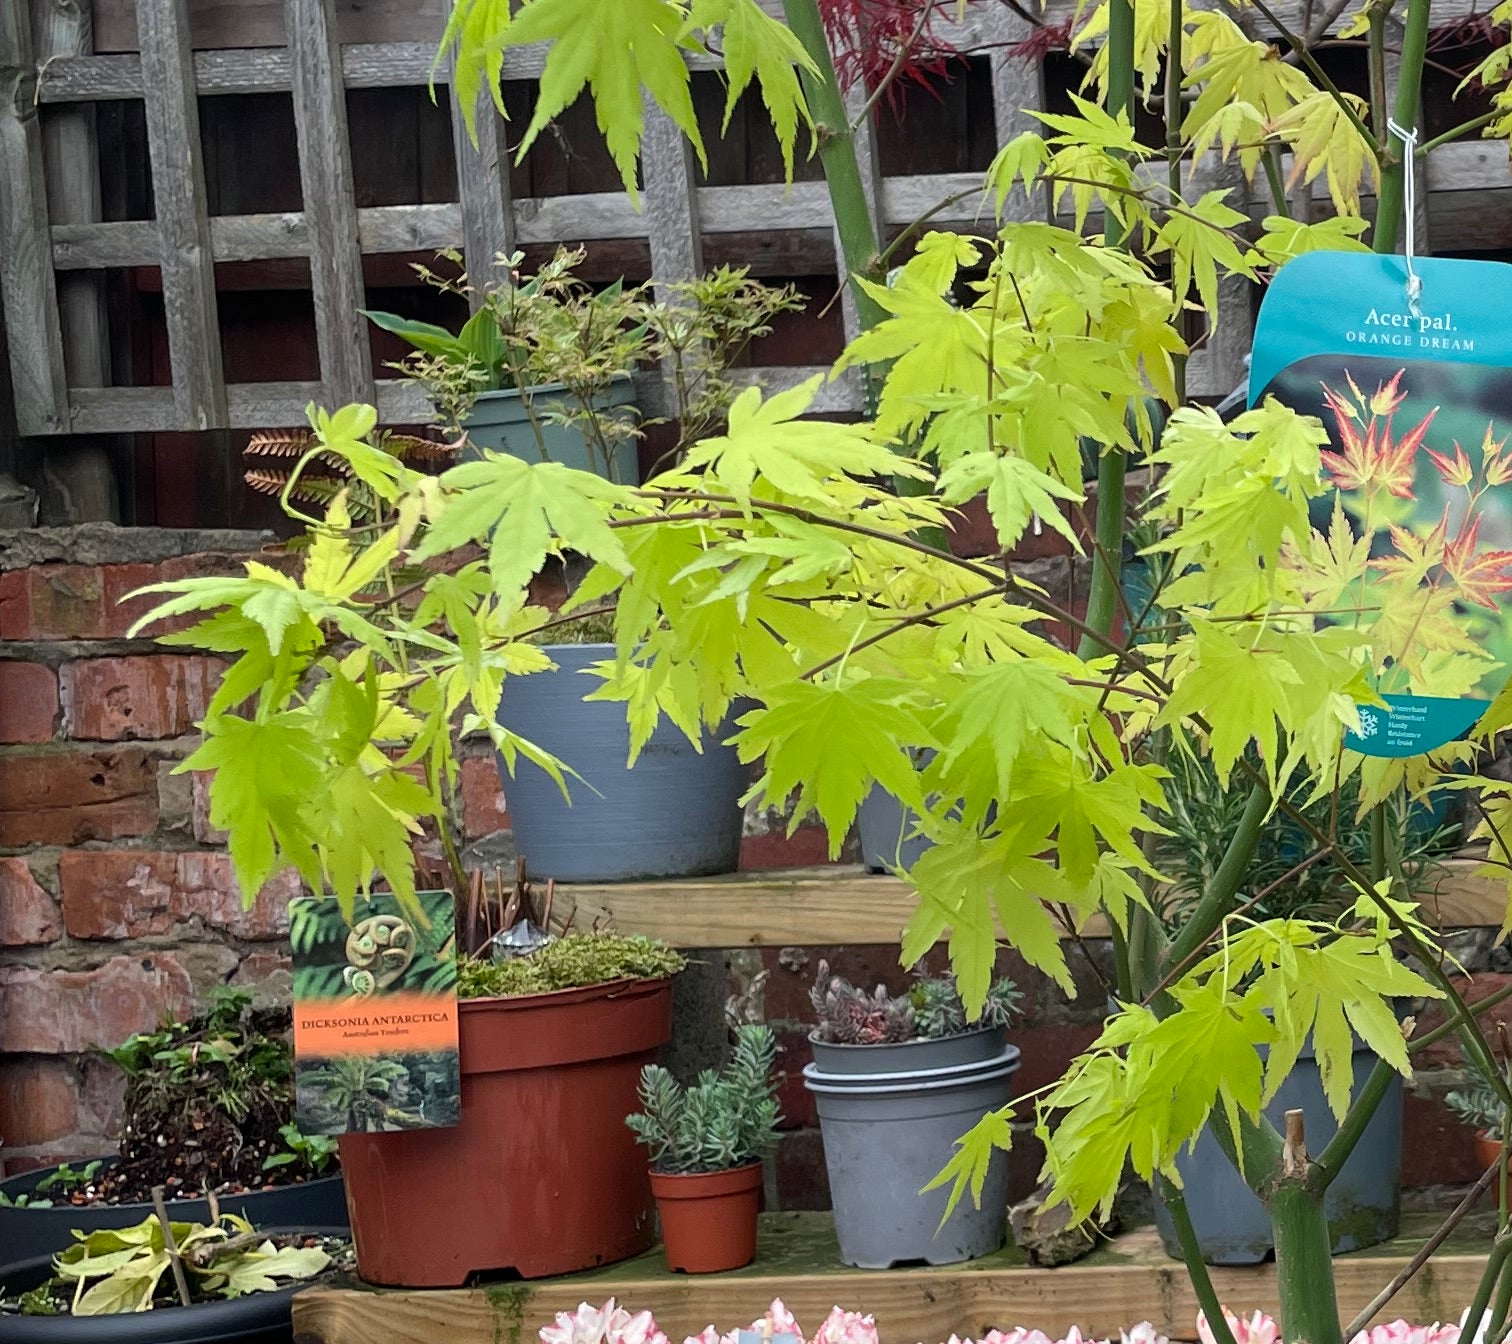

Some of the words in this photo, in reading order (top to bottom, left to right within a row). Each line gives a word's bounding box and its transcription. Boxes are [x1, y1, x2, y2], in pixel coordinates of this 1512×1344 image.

[1364, 308, 1412, 327] Acer
[1419, 313, 1458, 333] pal.
[1346, 331, 1412, 347] ORANGE
[1420, 336, 1474, 351] DREAM
[302, 1017, 369, 1029] DICKSONIA
[372, 1013, 449, 1026] ANTARCTICA
